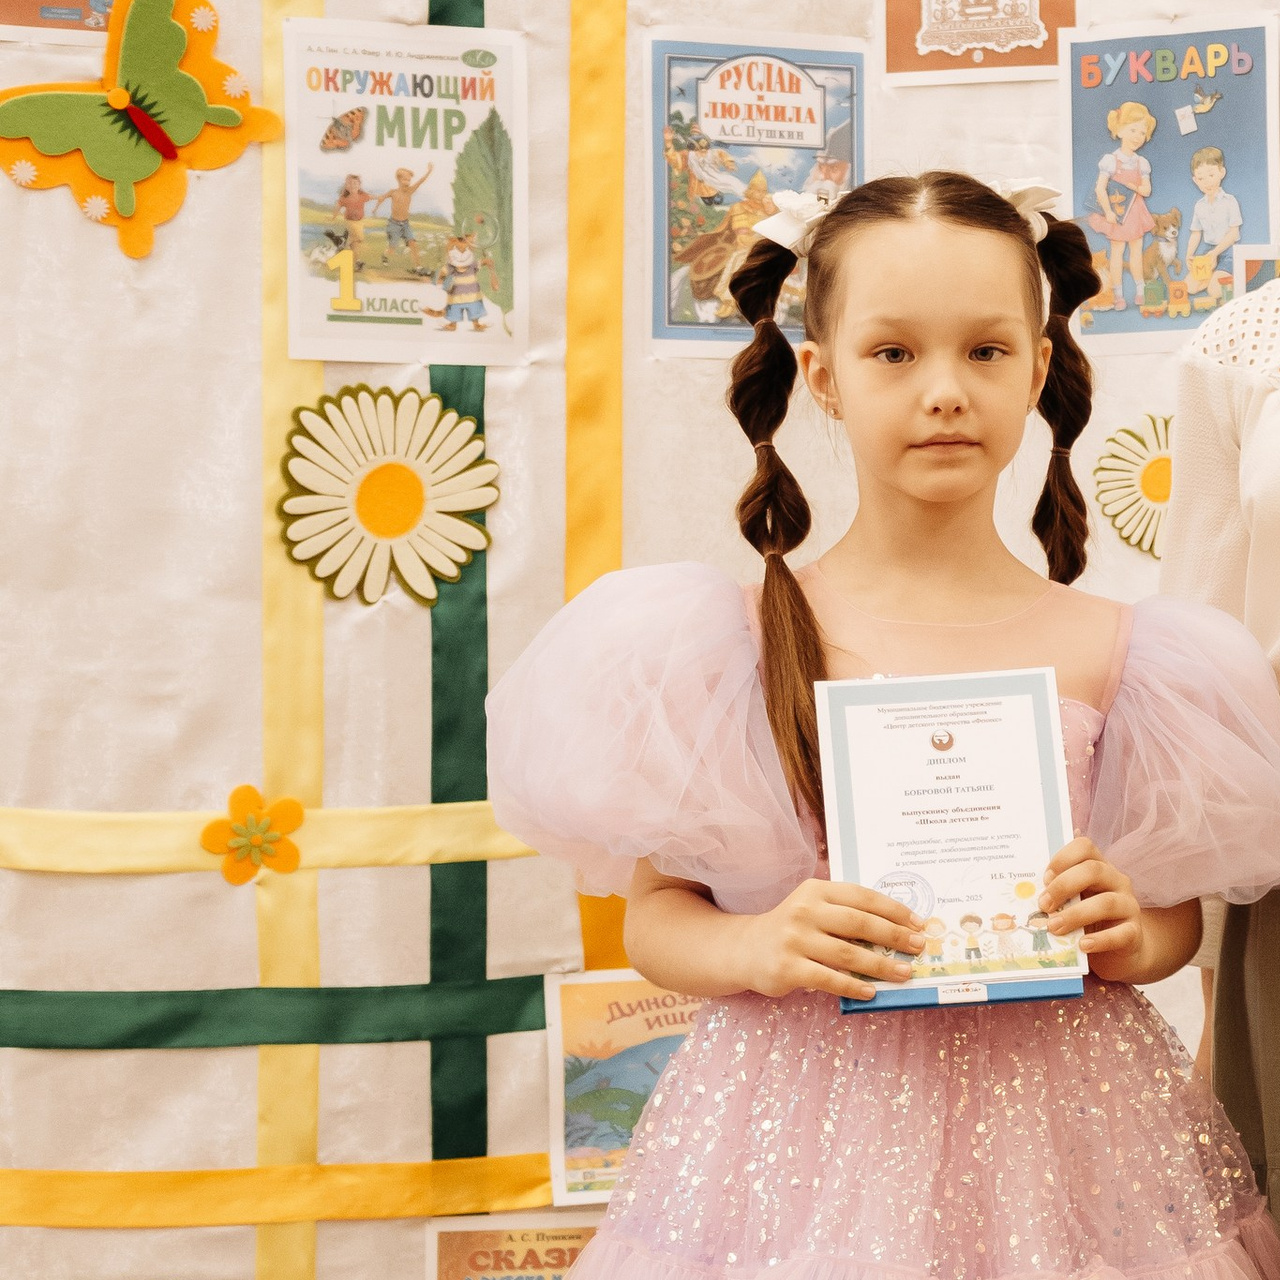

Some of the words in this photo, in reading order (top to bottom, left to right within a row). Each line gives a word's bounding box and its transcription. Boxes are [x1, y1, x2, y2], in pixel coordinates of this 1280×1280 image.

[1080, 42, 1254, 89] БУКВАРЬ
[306, 66, 496, 106] ОКРУЖАЮЩИЙ
[719, 61, 802, 95] РУСЛАН
[704, 101, 816, 125] ЛЮДМИЛА
[375, 105, 466, 150] МИР
[746, 125, 805, 142] Пушкин
[326, 250, 362, 311] 1
[366, 297, 419, 314] КЛАСС
[926, 756, 967, 767] ДИПЛОМ
[904, 786, 953, 797] БОБРОВОЙ
[954, 784, 995, 794] ТАТЬЯНЕ
[901, 807, 950, 817] выпускнику
[915, 818, 948, 826] «Школа
[965, 894, 983, 904] 2025
